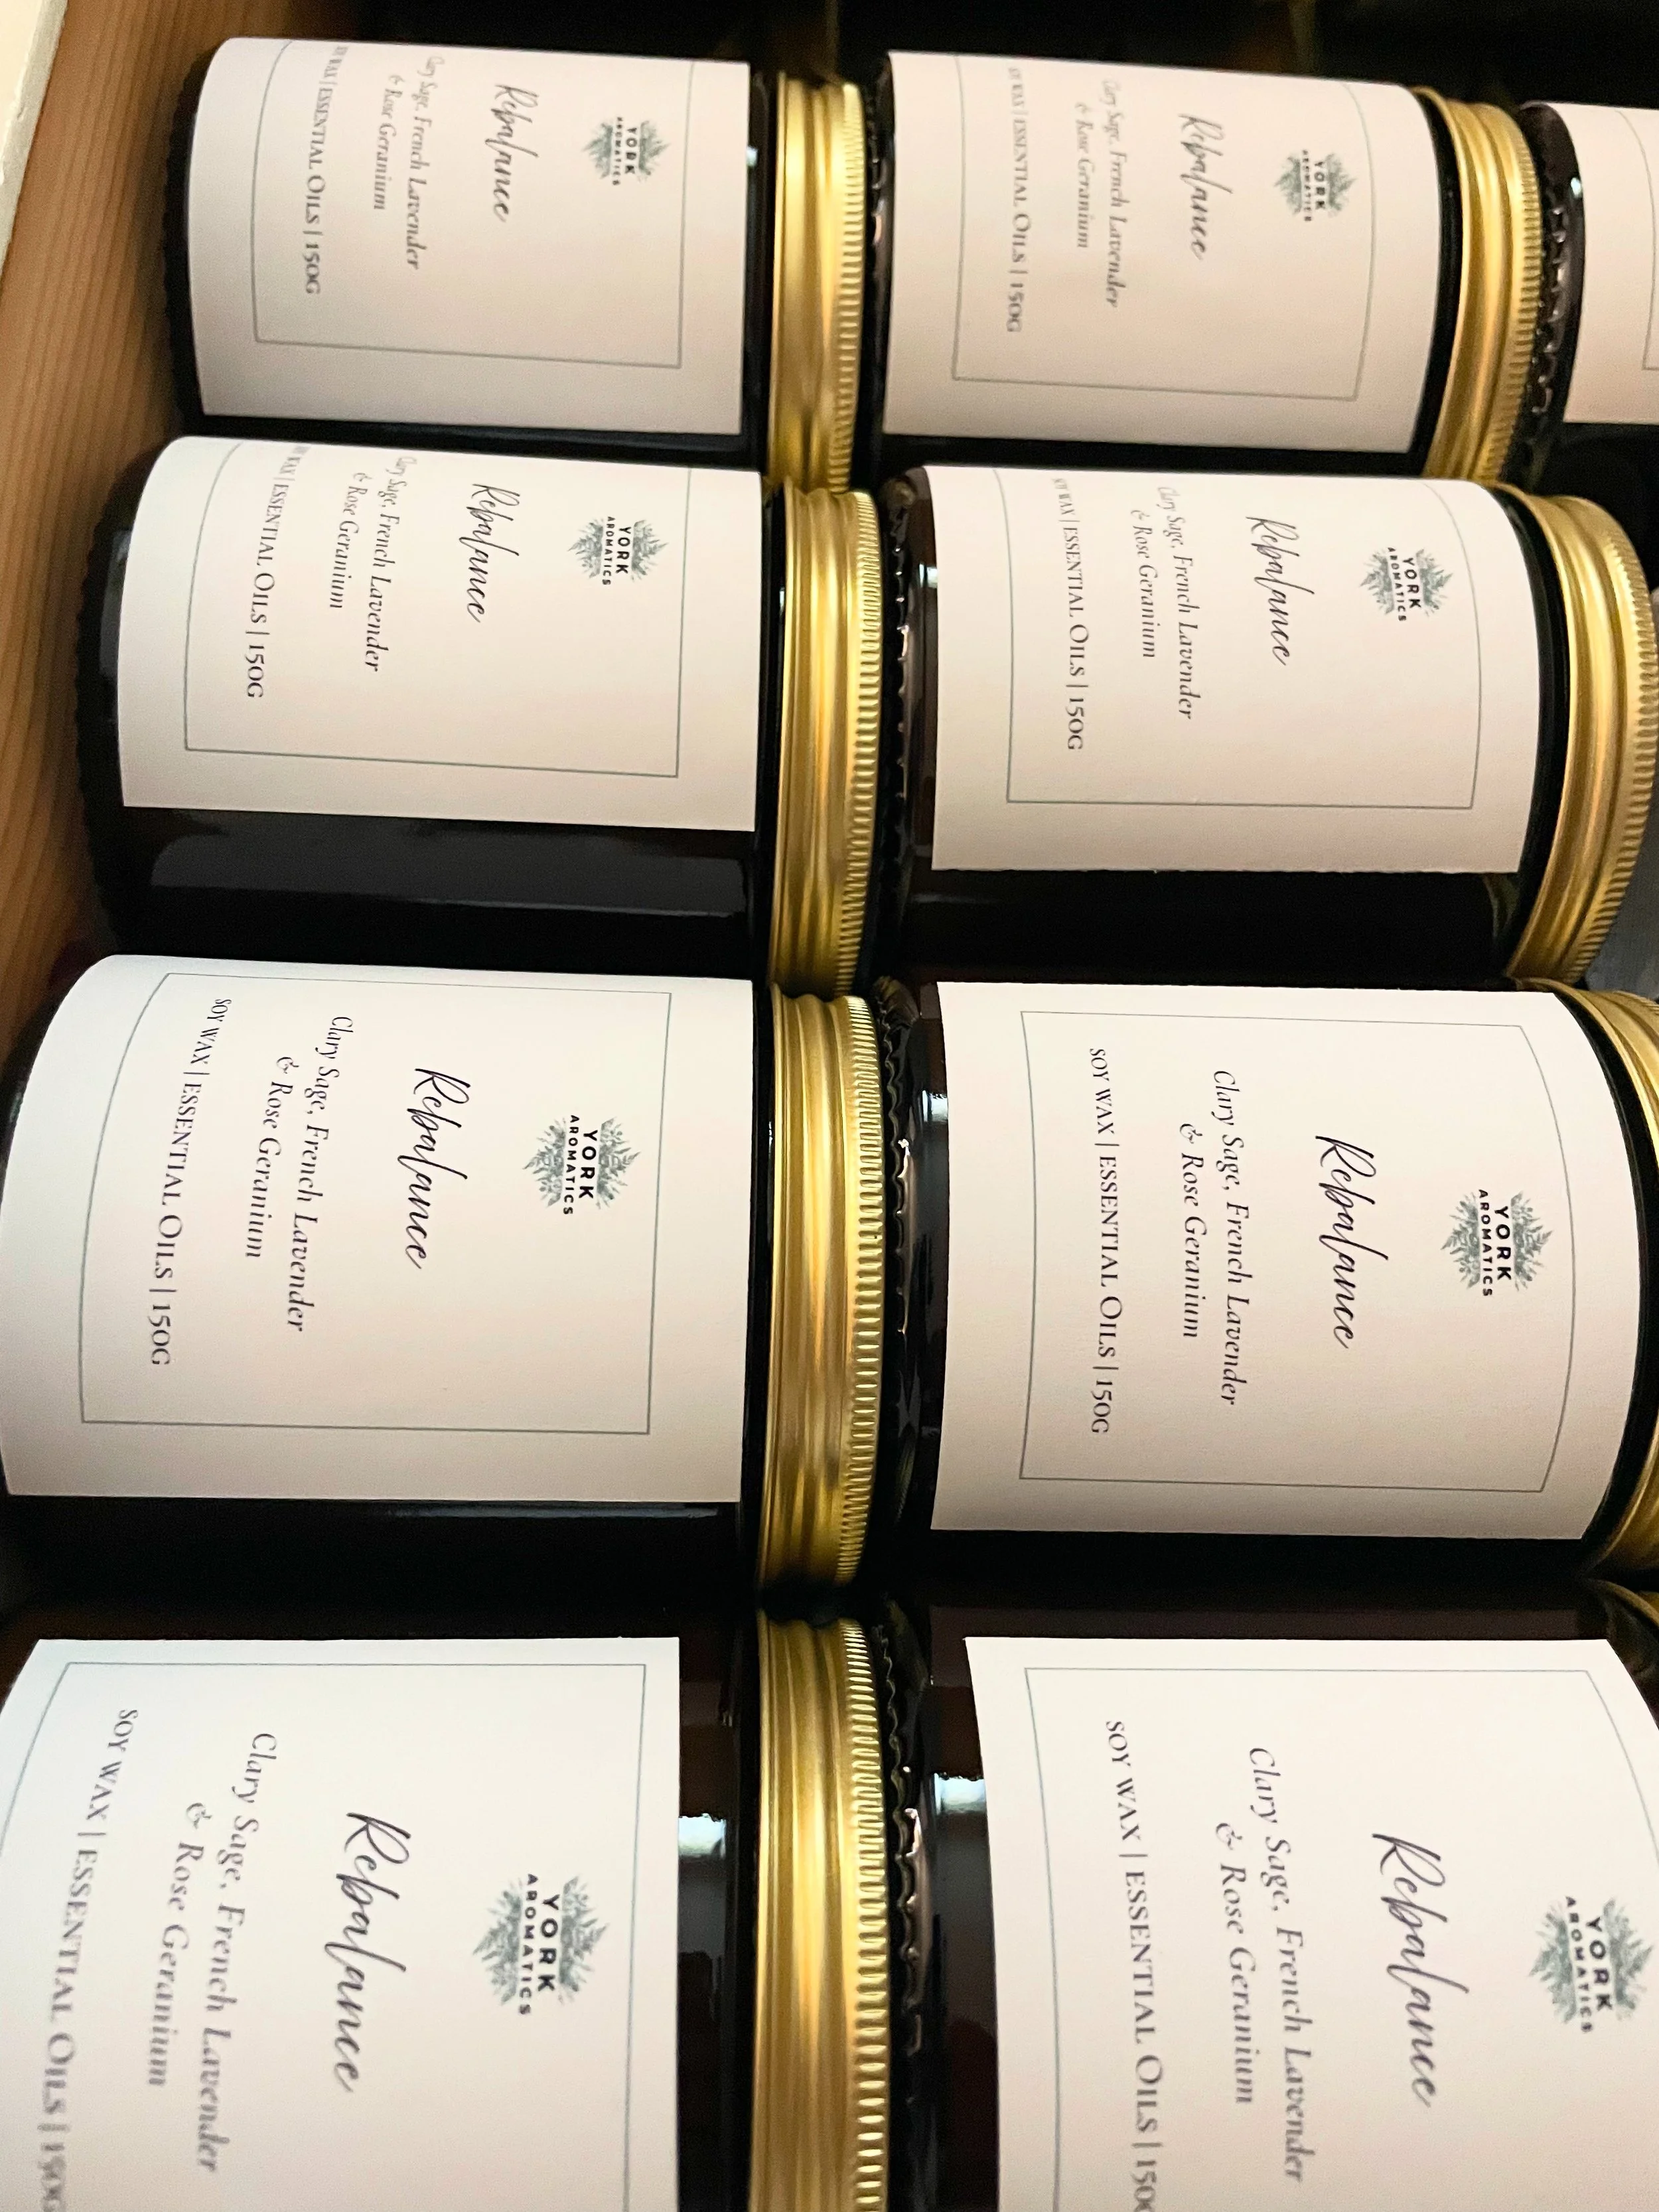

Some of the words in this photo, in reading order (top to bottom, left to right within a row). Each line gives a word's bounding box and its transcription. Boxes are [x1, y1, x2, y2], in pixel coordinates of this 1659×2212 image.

[308, 87, 333, 170] ESSENTIAL
[381, 88, 403, 119] Rose
[373, 122, 397, 210] Geranium
[409, 115, 433, 171] French
[484, 84, 539, 222] Rebalance
[624, 126, 638, 175] YORK
[305, 175, 326, 224] OILS
[1076, 157, 1095, 248] Geranium
[1109, 151, 1131, 208] French
[1178, 114, 1233, 258] Rebalance
[1313, 160, 1327, 212] YORK
[405, 177, 428, 270] Lavender
[1011, 212, 1031, 263] OILS
[303, 243, 321, 294] 150G
[1106, 215, 1128, 308] Lavender
[1006, 283, 1025, 332] 150G
[256, 484, 289, 566] ESSENTIAL
[342, 486, 368, 516] Rose
[377, 479, 407, 508] Sage,
[1130, 509, 1151, 521] &
[329, 520, 359, 609] Geranium
[372, 513, 400, 567] French
[458, 483, 520, 623] Rebalance
[601, 516, 614, 587] AROMATICS
[615, 526, 631, 575] YORK
[1132, 526, 1153, 559] Rose
[1162, 515, 1185, 549] Sage,
[250, 572, 275, 624] OILS
[1062, 527, 1084, 618] ESSENTIAL
[1173, 555, 1200, 613] French
[1246, 516, 1315, 666] Rebalance
[1387, 547, 1406, 622] AROMATICS
[1402, 556, 1421, 611] YORK
[364, 575, 392, 672] Lavender
[1139, 564, 1161, 658] Geranium
[245, 644, 265, 698] 150G
[1069, 624, 1089, 677] OILS
[1178, 621, 1202, 720] Lavender
[1066, 698, 1084, 750] 150G
[190, 1027, 220, 1065] WAX
[206, 999, 232, 1022] SOY
[315, 1016, 354, 1059] Clary
[276, 1056, 300, 1074] &
[304, 1066, 340, 1114] Sage,
[1090, 1048, 1110, 1082] SOY
[1210, 1070, 1240, 1126] Clary
[263, 1081, 294, 1129] Rose
[1095, 1088, 1115, 1135] WAX
[1179, 1123, 1203, 1144] &
[161, 1083, 202, 1206] ESSENTIAL
[297, 1124, 330, 1202] French
[397, 1068, 471, 1270] Rebalance
[562, 1114, 579, 1216] AROMATICS
[579, 1128, 598, 1201] YORK
[1181, 1152, 1204, 1207] Rose
[1216, 1134, 1244, 1191] Sage,
[245, 1137, 281, 1258] Geranium
[1099, 1156, 1119, 1288] ESSENTIAL
[155, 1215, 182, 1279] OILS
[287, 1213, 319, 1332] Lavender
[1183, 1216, 1208, 1337] Geranium
[1226, 1201, 1254, 1284] French
[1315, 1135, 1389, 1349] Rebalance
[1477, 1188, 1493, 1298] AROMATICS
[1493, 1206, 1512, 1282] YORK
[149, 1304, 171, 1365] 150G
[1098, 1295, 1123, 1358] OILS
[1220, 1293, 1250, 1406] Lavender
[1091, 1380, 1114, 1434] 150G
[108, 1709, 139, 1752] SOY
[1106, 1721, 1131, 1767] SOY
[86, 1761, 123, 1820] WAX
[231, 1733, 277, 1804] Clary
[1249, 1747, 1281, 1824] Clary
[186, 1802, 212, 1830] &
[1116, 1777, 1140, 1841] WAX
[1215, 1822, 1243, 1850] &
[168, 1842, 204, 1911] Rose
[1220, 1864, 1247, 1935] Rose
[1260, 1836, 1291, 1911] Sage,
[50, 1849, 98, 2022] ESSENTIAL
[205, 1903, 246, 2012] French
[324, 1812, 411, 2091] Rebalance
[518, 1873, 538, 2017] AROMATICS
[536, 1893, 559, 1995] YORK
[1125, 1871, 1156, 2044] ESSENTIAL
[1371, 1833, 1470, 2107] Rebalance
[1563, 1895, 1593, 2034] AROMATICS
[1584, 1916, 1614, 2014] YORK
[148, 1924, 189, 2087] Geranium
[1276, 1927, 1313, 2032] French
[1229, 1947, 1260, 2103] Geranium
[42, 2031, 76, 2116] OILS
[197, 2027, 232, 2173] Lavender
[1135, 2054, 1163, 2134] OILS
[1284, 2046, 1316, 2183] Lavender
